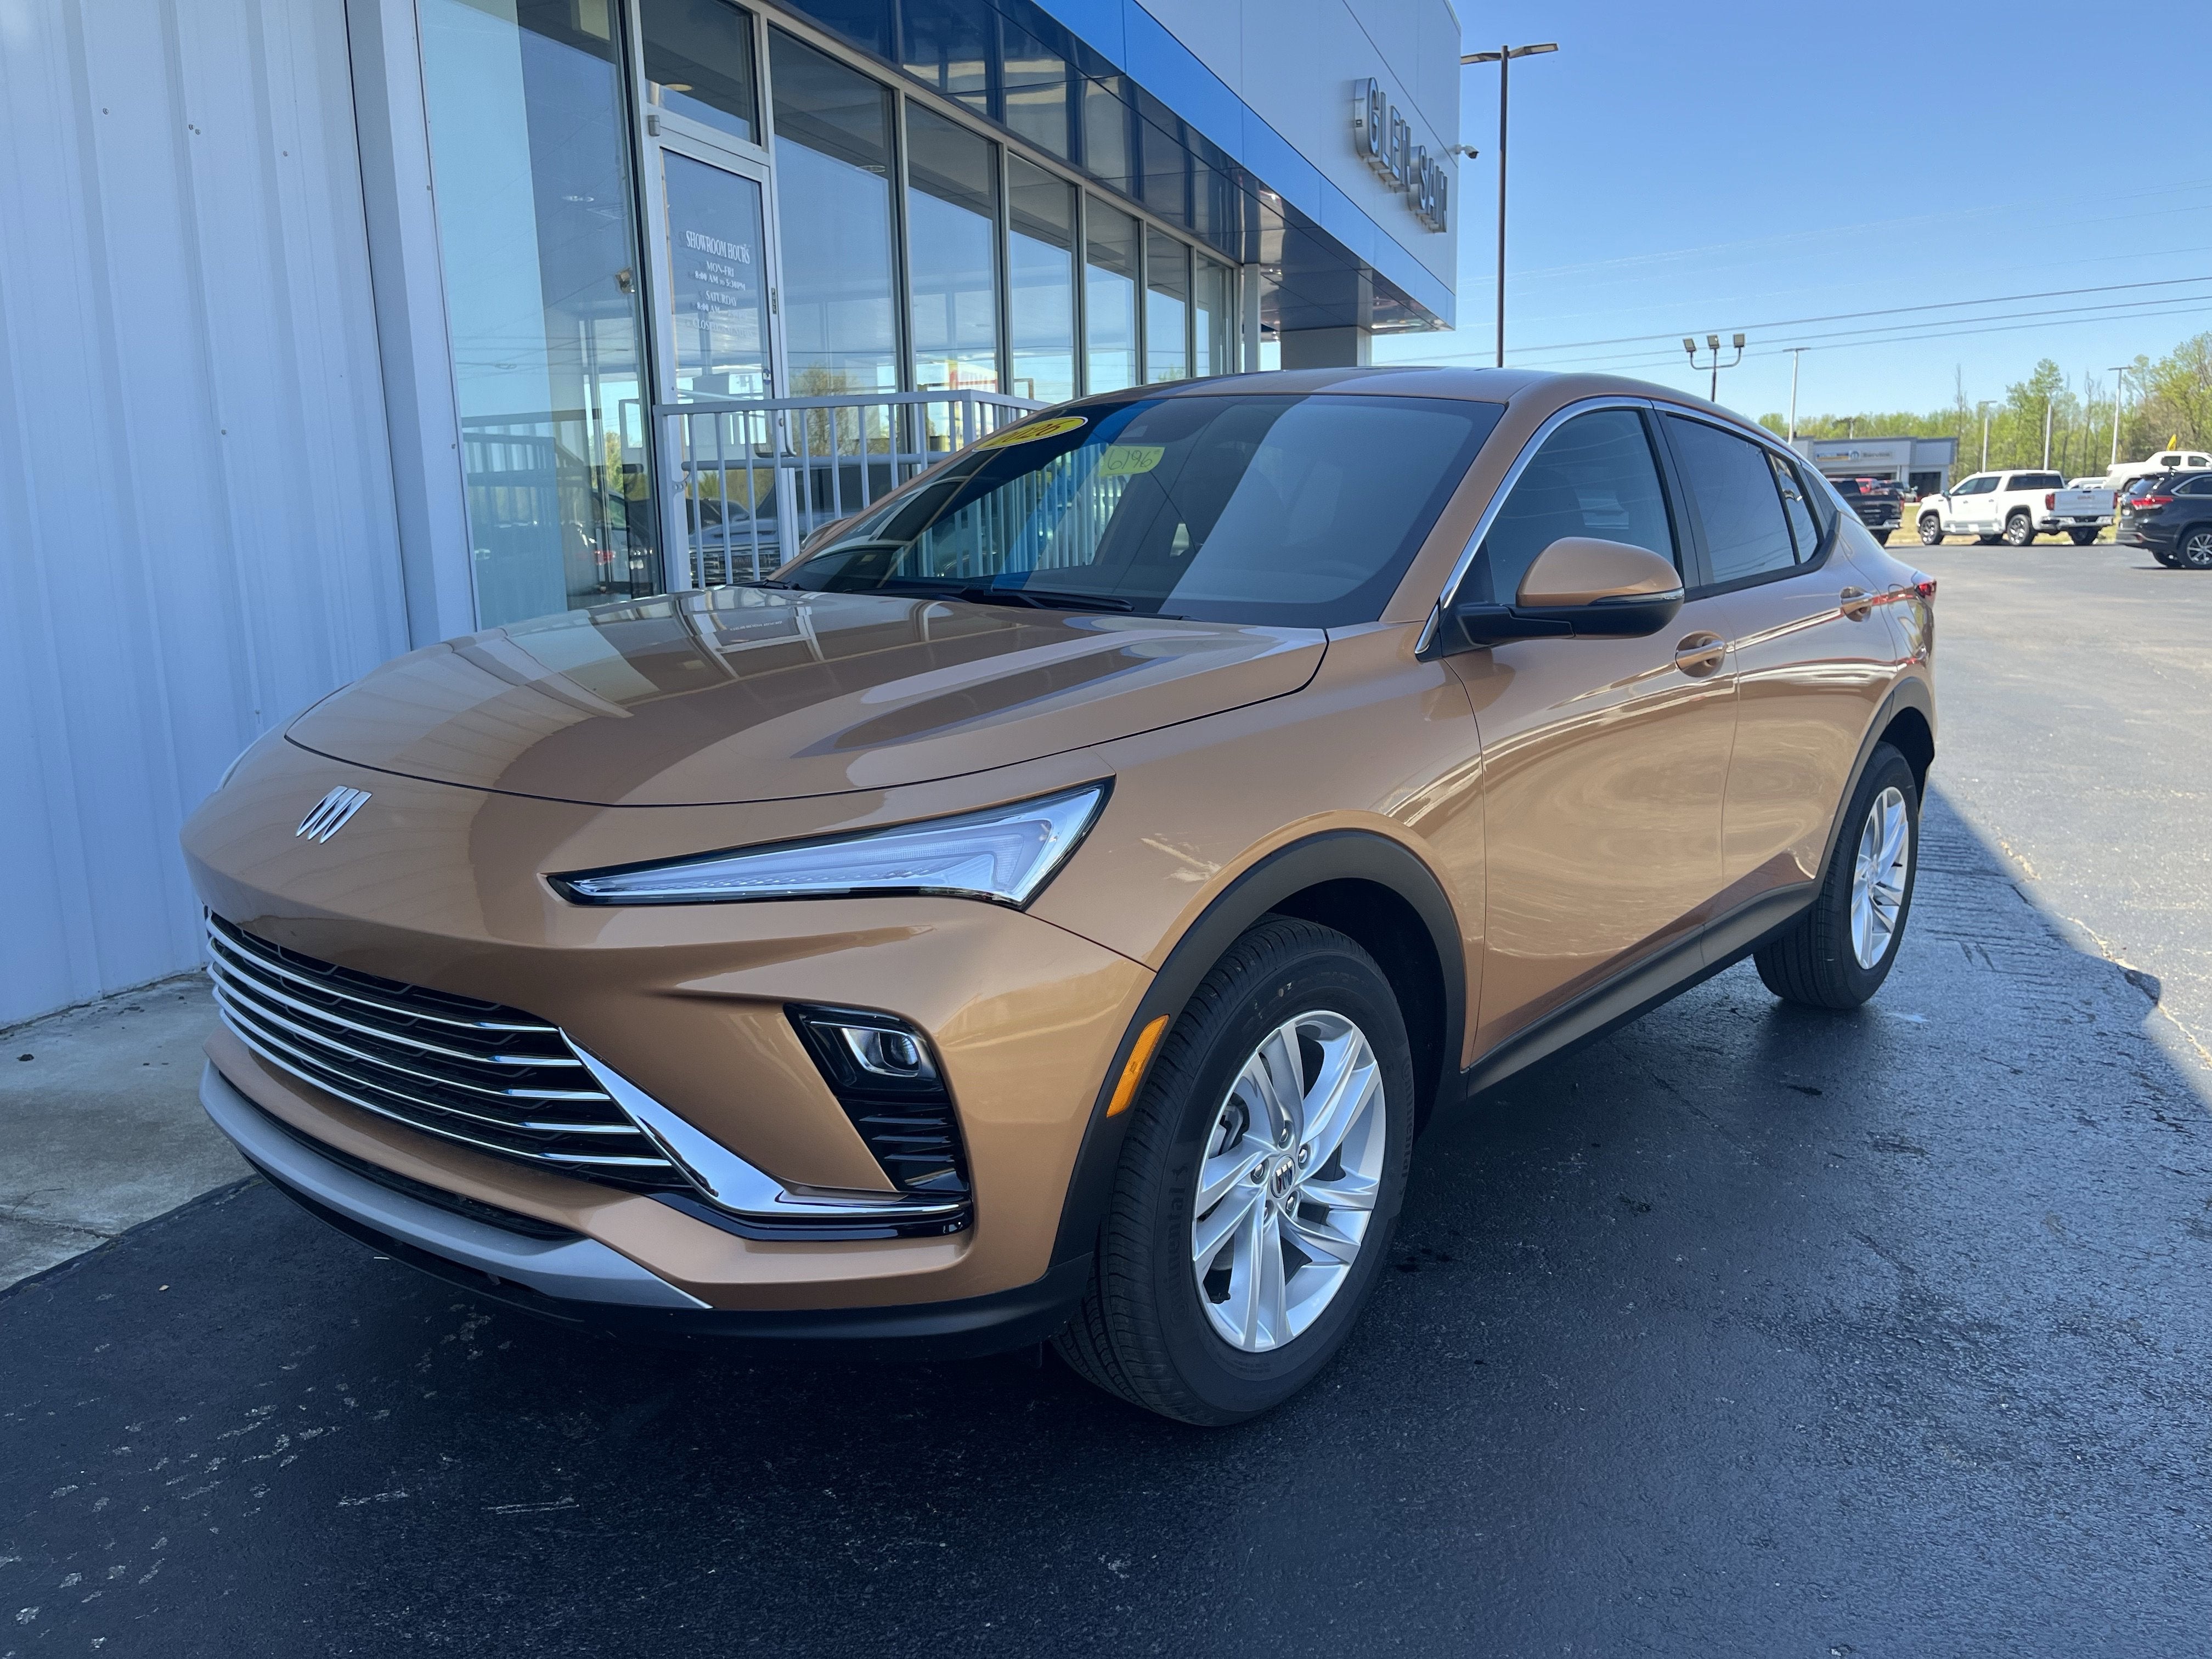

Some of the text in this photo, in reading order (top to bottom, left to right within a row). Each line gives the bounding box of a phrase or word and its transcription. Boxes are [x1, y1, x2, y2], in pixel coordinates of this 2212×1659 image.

[1353, 77, 1410, 191] GLEN
[686, 230, 751, 264] SHOWROOM HOURS
[695, 270, 707, 281] 8:00
[708, 273, 719, 284] AM
[706, 260, 734, 278] MON-FRI
[706, 290, 737, 307] SATURDAY
[697, 302, 720, 314] 8:00 AM
[1108, 449, 1153, 470] 6196
